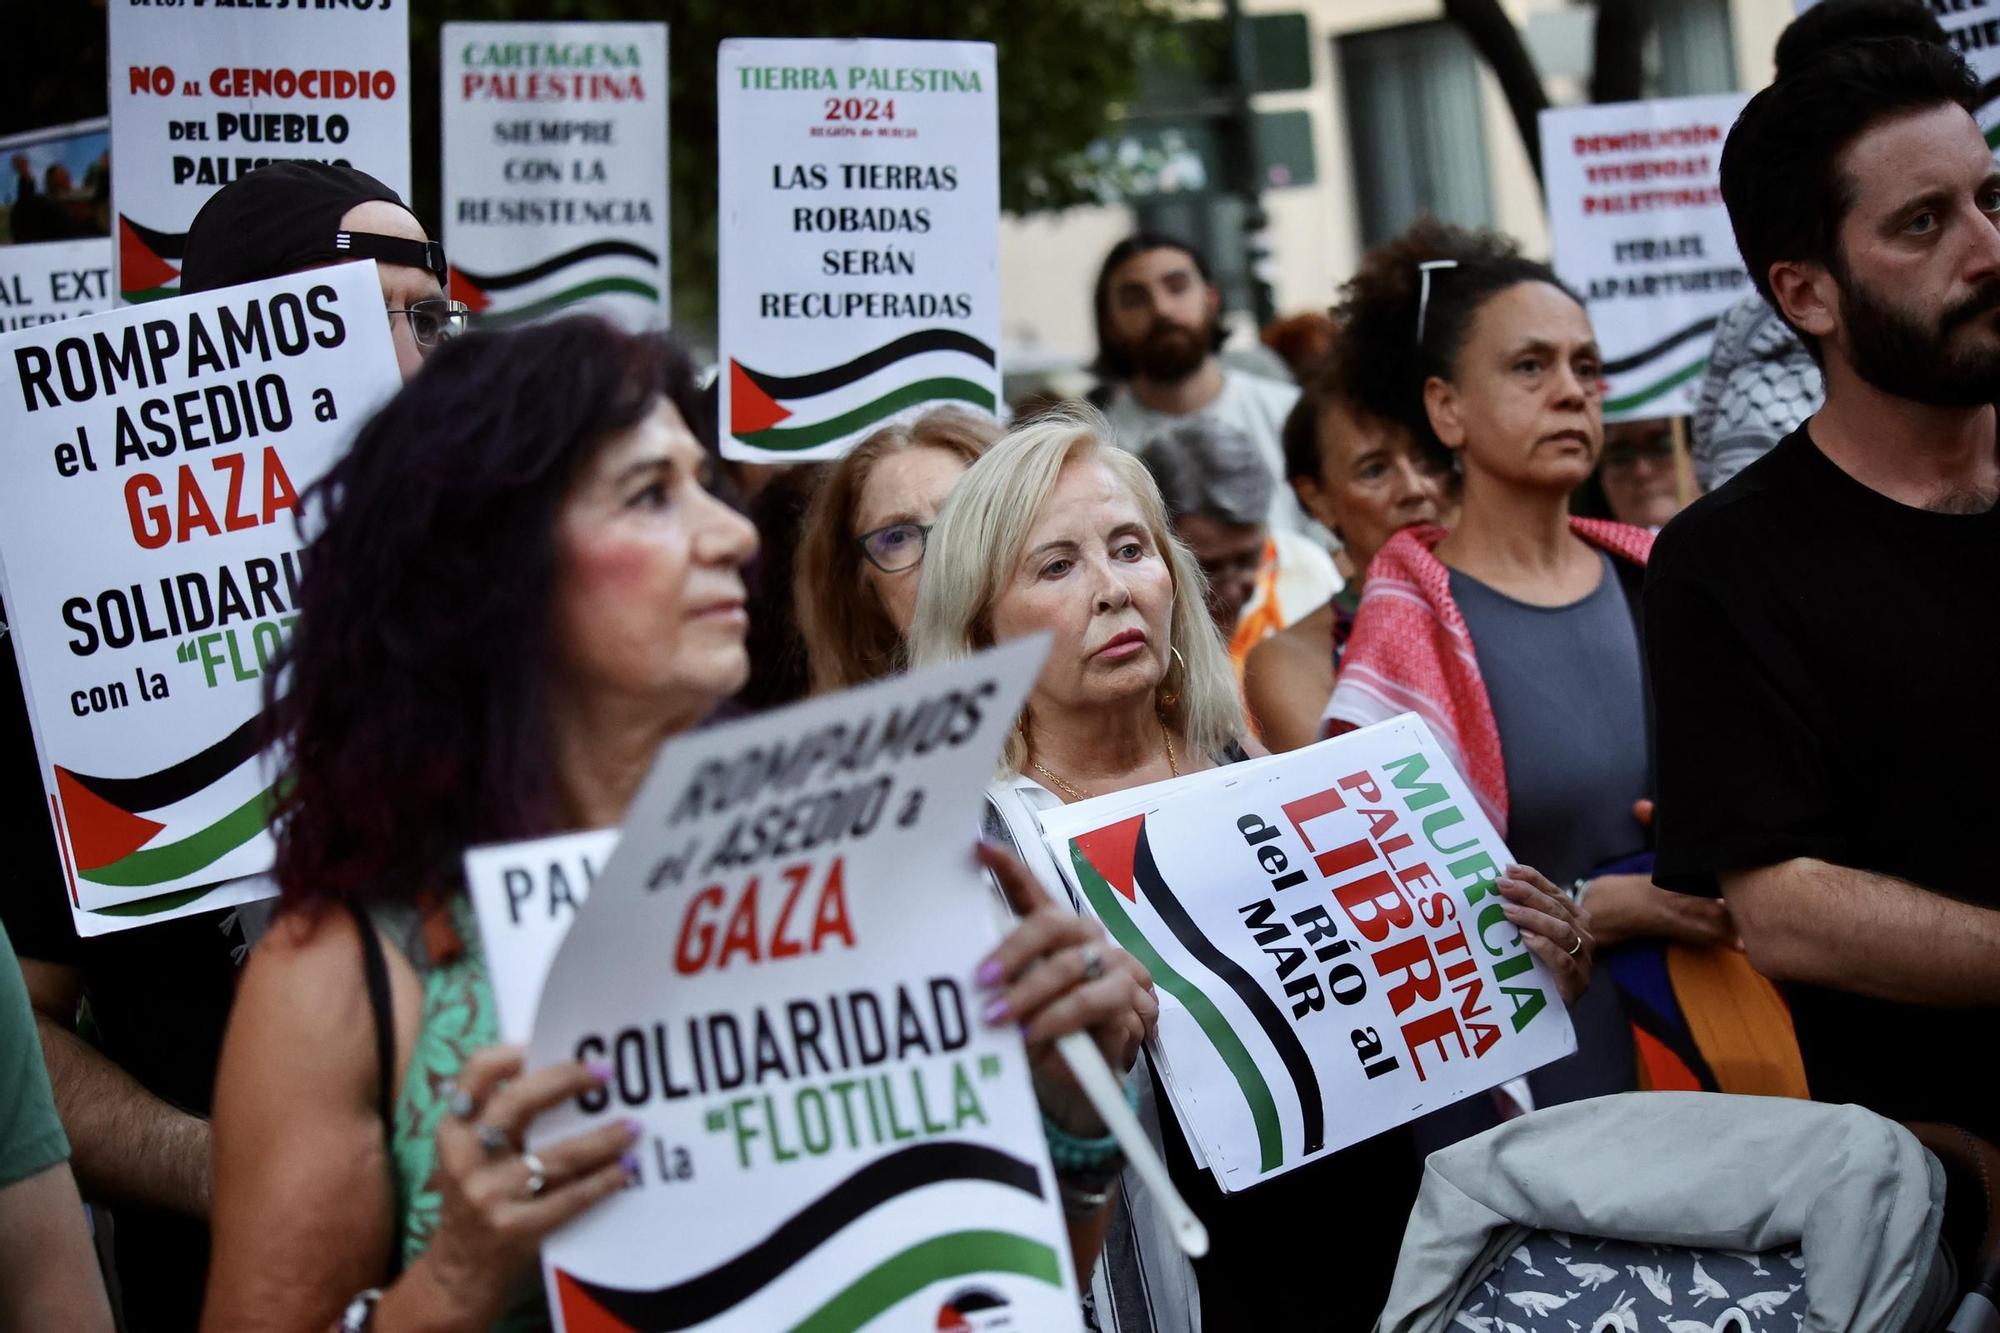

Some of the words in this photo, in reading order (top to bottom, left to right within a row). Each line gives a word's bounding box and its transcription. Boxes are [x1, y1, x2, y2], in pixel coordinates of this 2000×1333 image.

[461, 43, 640, 67] CARTAGENA
[129, 66, 175, 96] NO
[210, 67, 396, 100] GENOCIDIO
[462, 73, 645, 101] PALESTINA
[737, 67, 837, 91] TIERRA
[849, 67, 982, 93] PALESTINA
[169, 120, 209, 141] DEL
[217, 112, 349, 144] PUEBLO
[494, 120, 613, 144] SIEMPRE
[825, 98, 895, 121] 2024
[504, 159, 562, 183] CON
[572, 158, 606, 182] LA
[773, 164, 828, 190] LAS
[839, 164, 958, 191] TIERRAS
[457, 199, 652, 224] RESISTENCIA
[793, 206, 931, 233] ROBADAS
[822, 244, 915, 275] SERÁN
[760, 292, 972, 319] RECUPERADAS
[14, 284, 346, 412] ROMPAMOS
[54, 426, 98, 477] el
[115, 373, 293, 467] ASEDIO
[312, 387, 338, 423] a
[124, 446, 303, 549] GAZA
[70, 677, 129, 716] con
[137, 667, 170, 702] la
[667, 679, 997, 826] ROMPAMOS
[702, 776, 893, 876] ASEDIO
[674, 855, 857, 977] GAZA
[1337, 770, 1501, 1059] PALESTINA
[1382, 752, 1547, 1034] MURCIA
[1236, 813, 1309, 892] del
[1290, 904, 1367, 1006] RÍO
[1350, 1026, 1400, 1080] al
[1281, 787, 1470, 1082] LIBRE
[1238, 898, 1326, 1021] MAR
[574, 976, 970, 1114] SOLIDARIDAD
[654, 1136, 694, 1183] la
